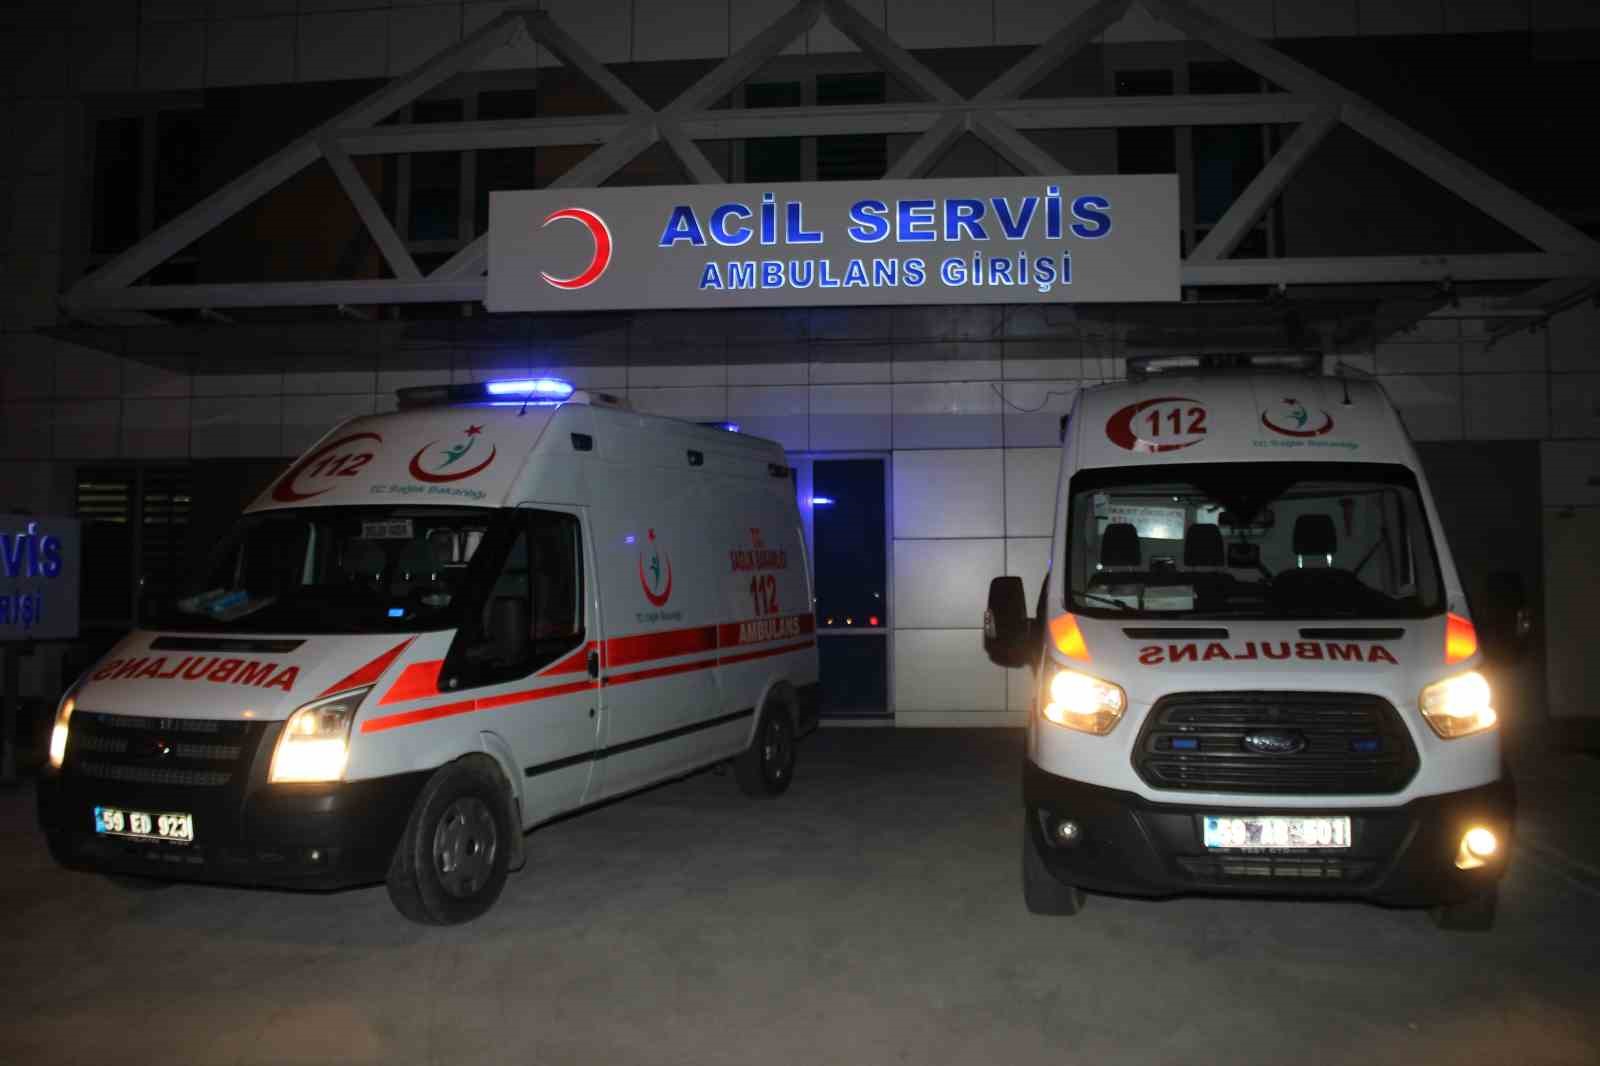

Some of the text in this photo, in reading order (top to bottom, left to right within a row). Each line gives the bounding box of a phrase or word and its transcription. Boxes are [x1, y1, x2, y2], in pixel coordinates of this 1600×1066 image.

[658, 185, 1112, 247] ACİL SERVİS
[699, 250, 1073, 292] AMBULANS GİRİŞİ
[1145, 407, 1207, 437] 112
[309, 453, 374, 478] 112
[750, 575, 779, 617] 112
[103, 808, 125, 832] 59
